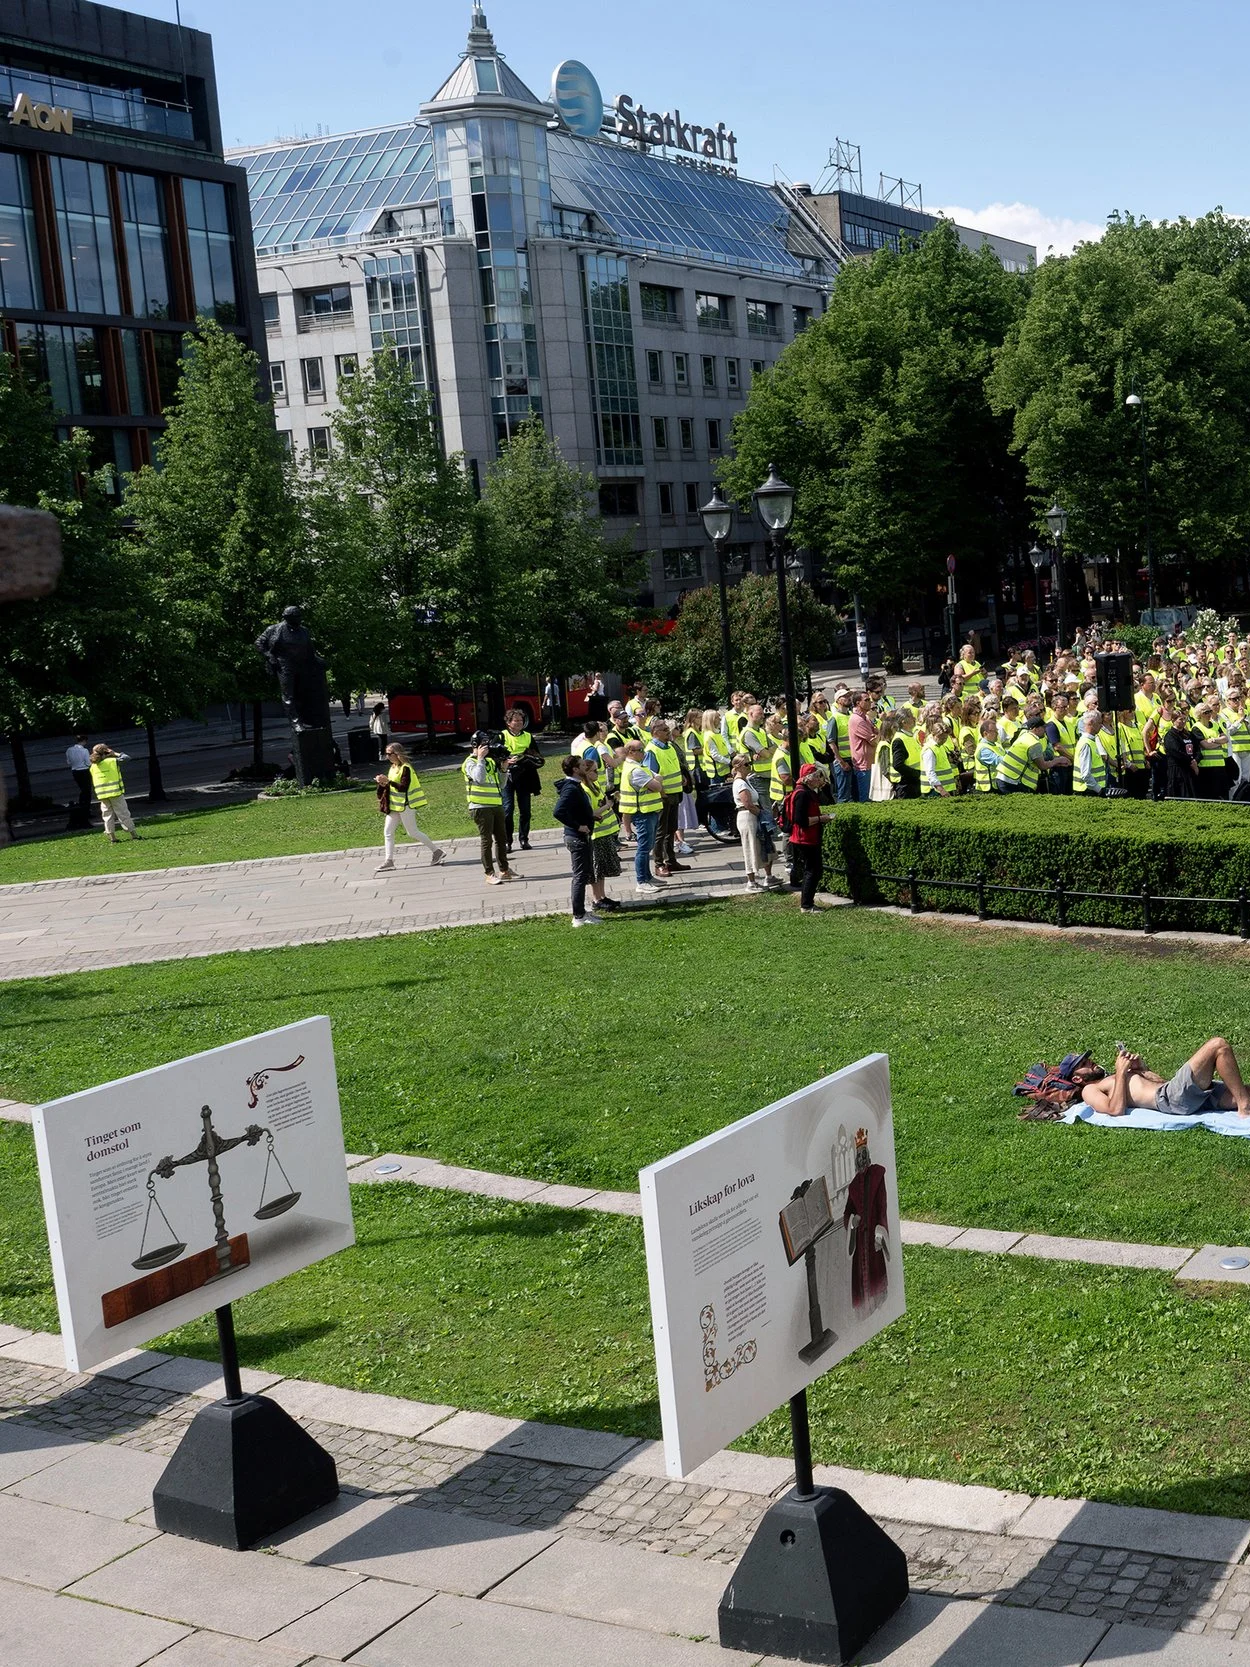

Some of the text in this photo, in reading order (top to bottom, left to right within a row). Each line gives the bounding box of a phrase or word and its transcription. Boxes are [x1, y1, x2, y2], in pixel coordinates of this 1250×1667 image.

[7, 92, 73, 135] AON
[615, 94, 737, 164] Statkraft
[84, 1122, 141, 1147] Tinget som
[86, 1138, 129, 1162] domstol
[689, 1173, 755, 1216] Likskap for lova
